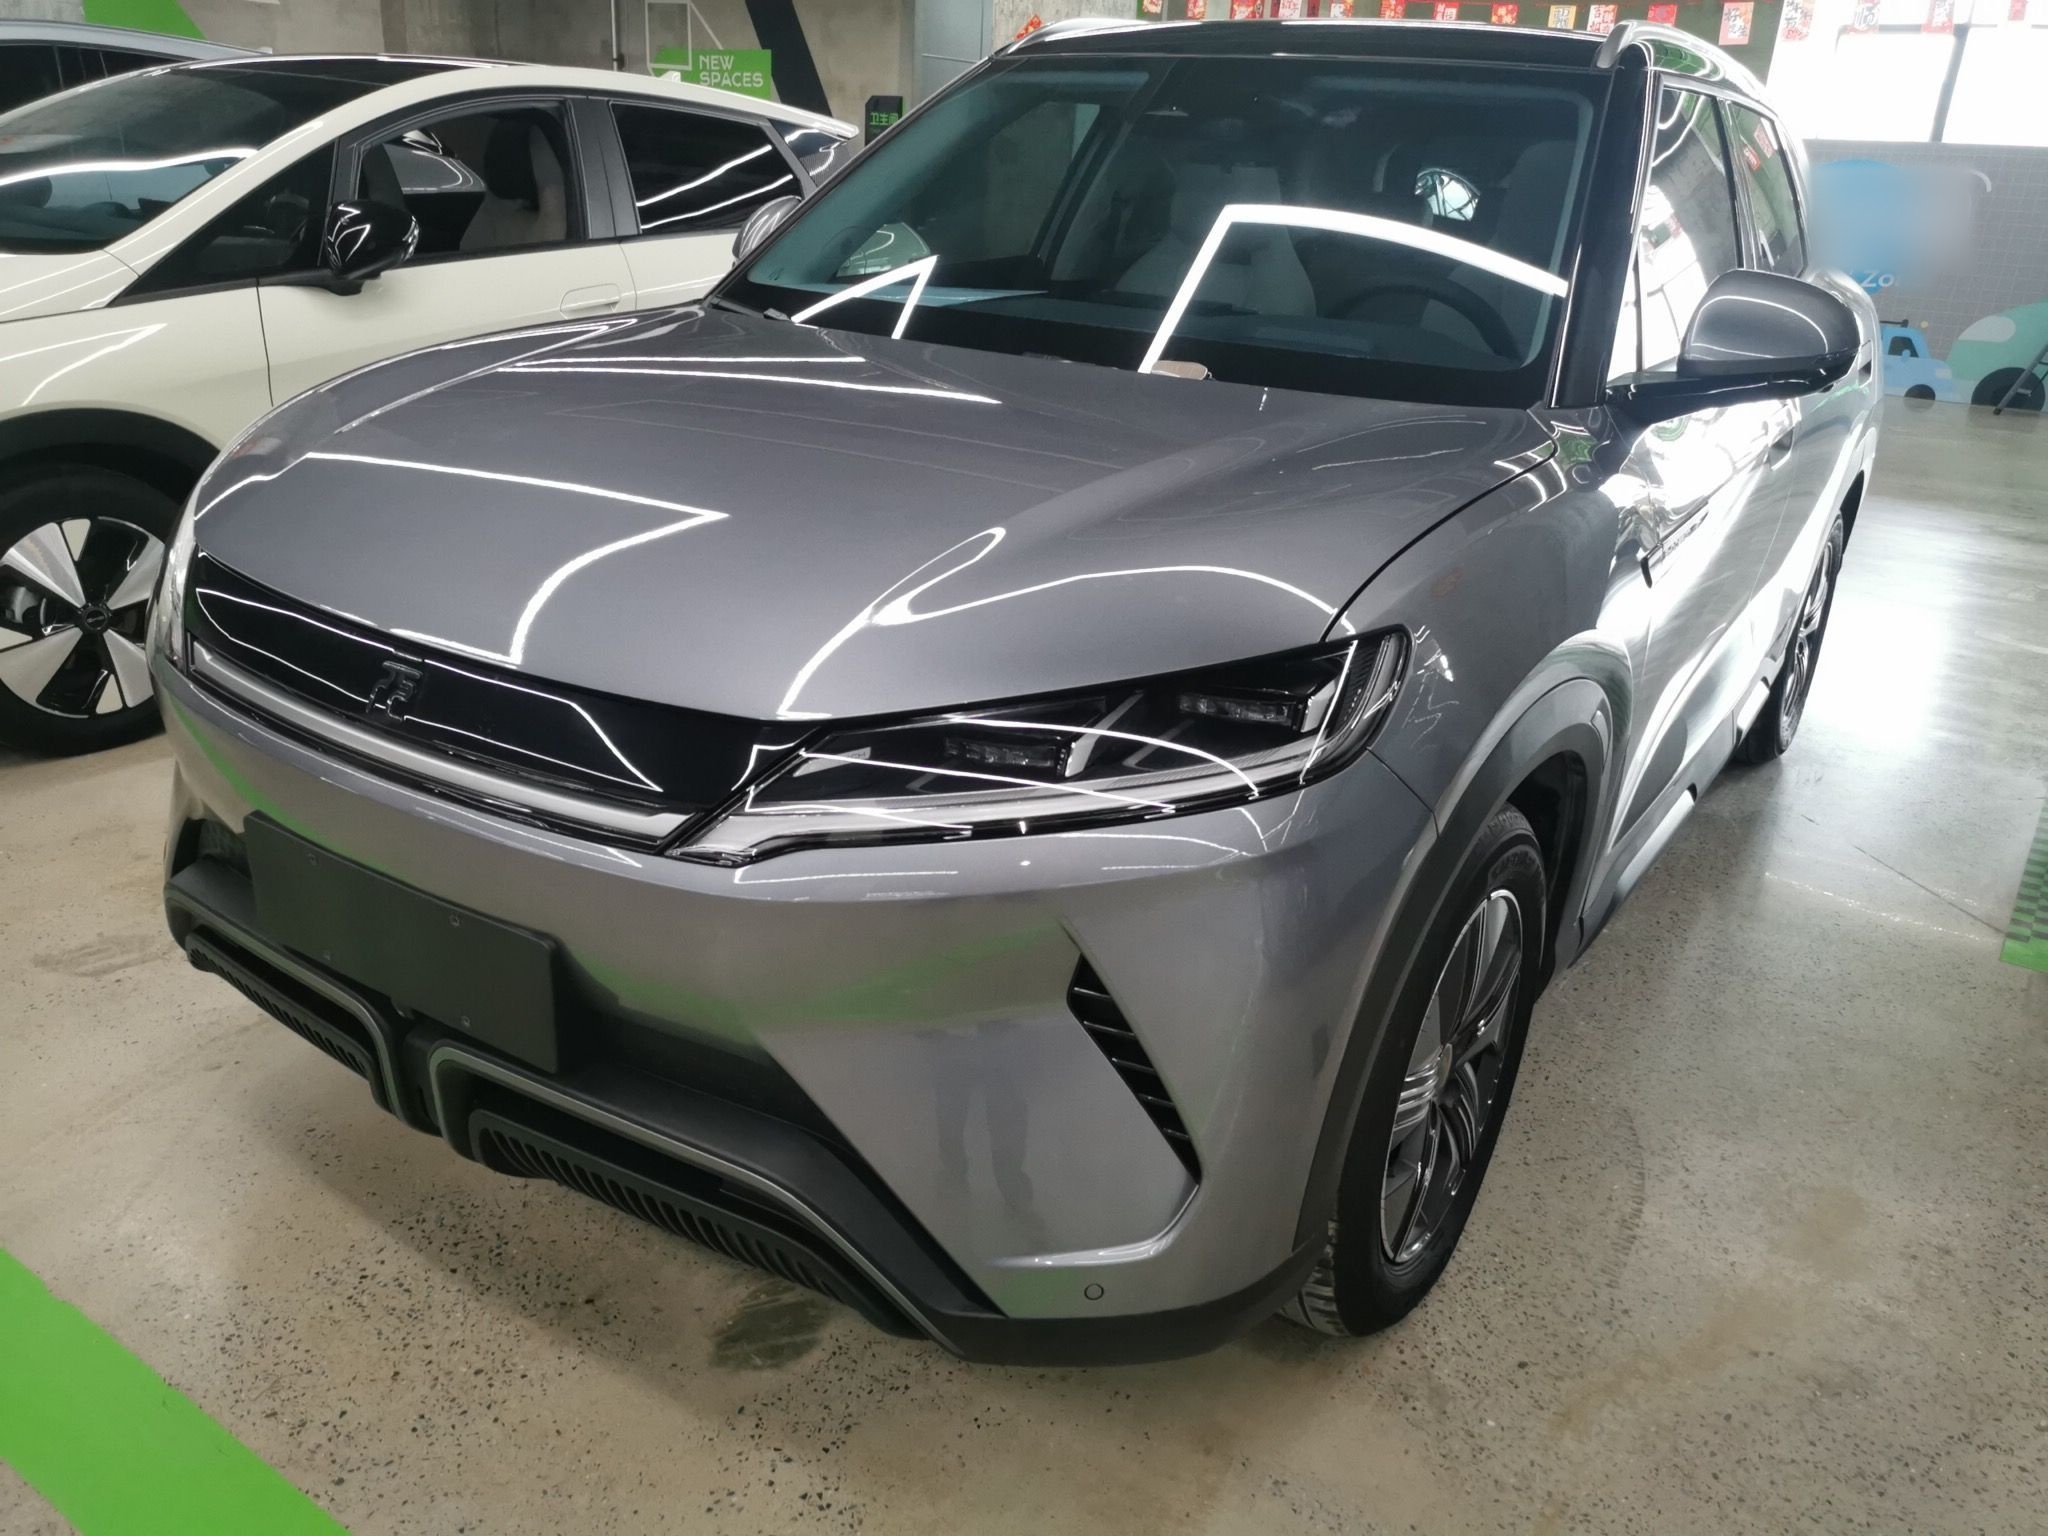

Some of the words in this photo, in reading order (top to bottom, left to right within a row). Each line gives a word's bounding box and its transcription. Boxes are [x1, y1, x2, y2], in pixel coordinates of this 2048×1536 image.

[699, 55, 735, 70] NEW
[699, 71, 764, 87] SPACES
[870, 112, 899, 126] 卫生间
[1861, 269, 1901, 288] Zo
